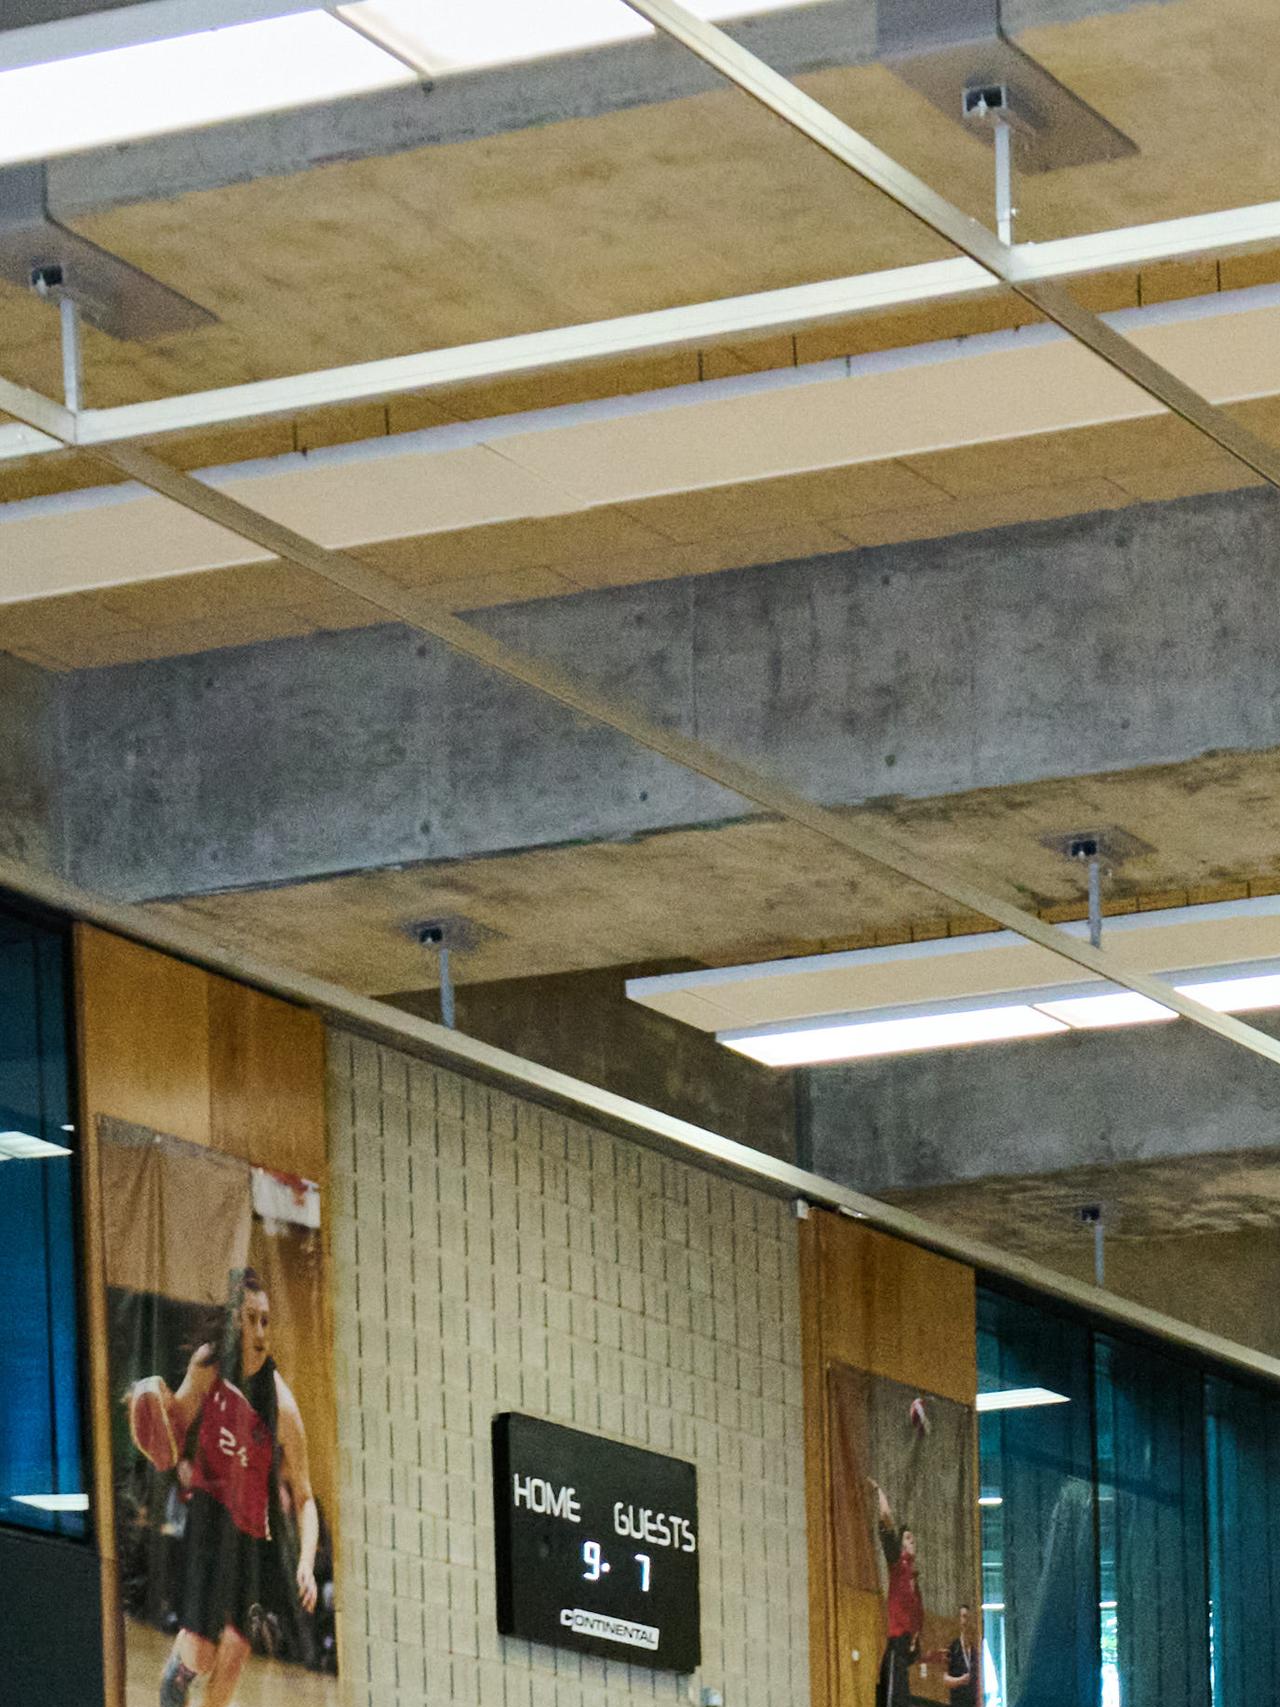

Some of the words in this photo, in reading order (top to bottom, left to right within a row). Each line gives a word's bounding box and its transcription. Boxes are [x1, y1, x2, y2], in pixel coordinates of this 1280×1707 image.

[513, 1473, 581, 1523] HOME
[613, 1502, 696, 1553] GUESTS
[634, 1554, 650, 1592] 7
[560, 1608, 657, 1647] CONTINENTAL
